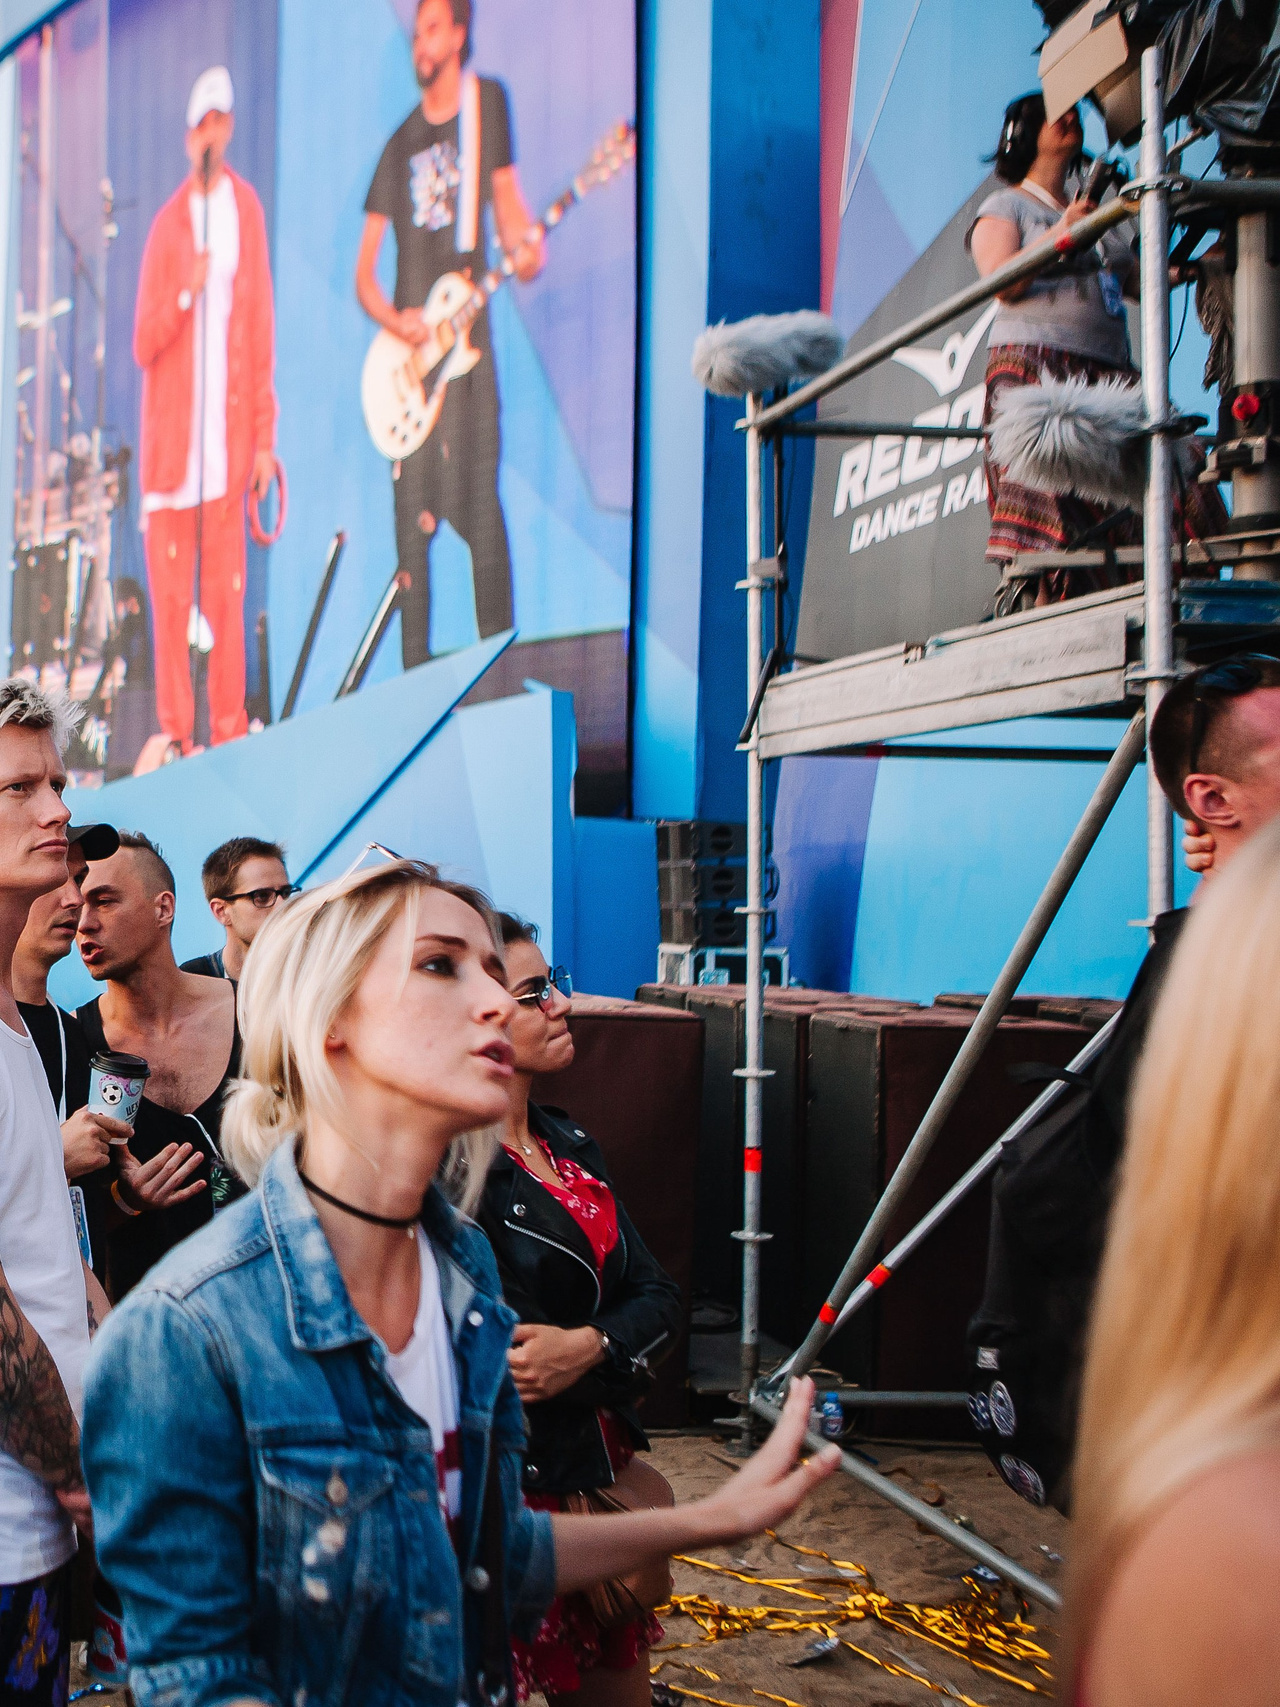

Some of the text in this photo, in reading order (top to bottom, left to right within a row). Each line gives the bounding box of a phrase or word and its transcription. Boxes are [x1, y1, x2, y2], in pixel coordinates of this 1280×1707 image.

[833, 382, 987, 518] RECO
[849, 466, 989, 554] DANCE RA
